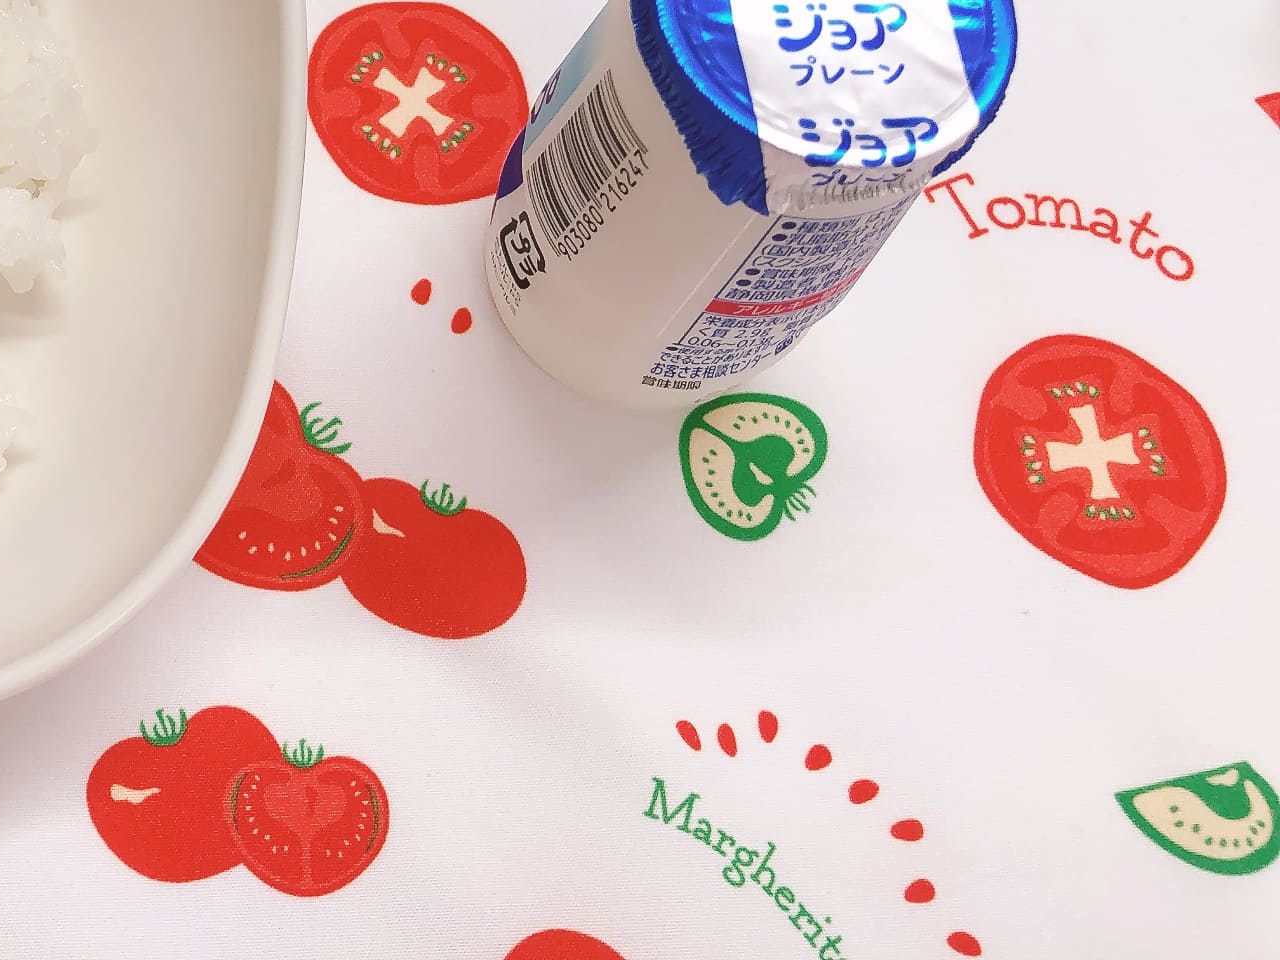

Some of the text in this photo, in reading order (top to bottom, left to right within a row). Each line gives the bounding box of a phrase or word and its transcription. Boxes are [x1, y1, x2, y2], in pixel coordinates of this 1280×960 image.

[772, 3, 908, 52] ジョア
[789, 55, 906, 86] プレーン
[798, 117, 939, 168] ジョア
[922, 172, 1195, 282] Tomato
[642, 776, 844, 960] Margherit
